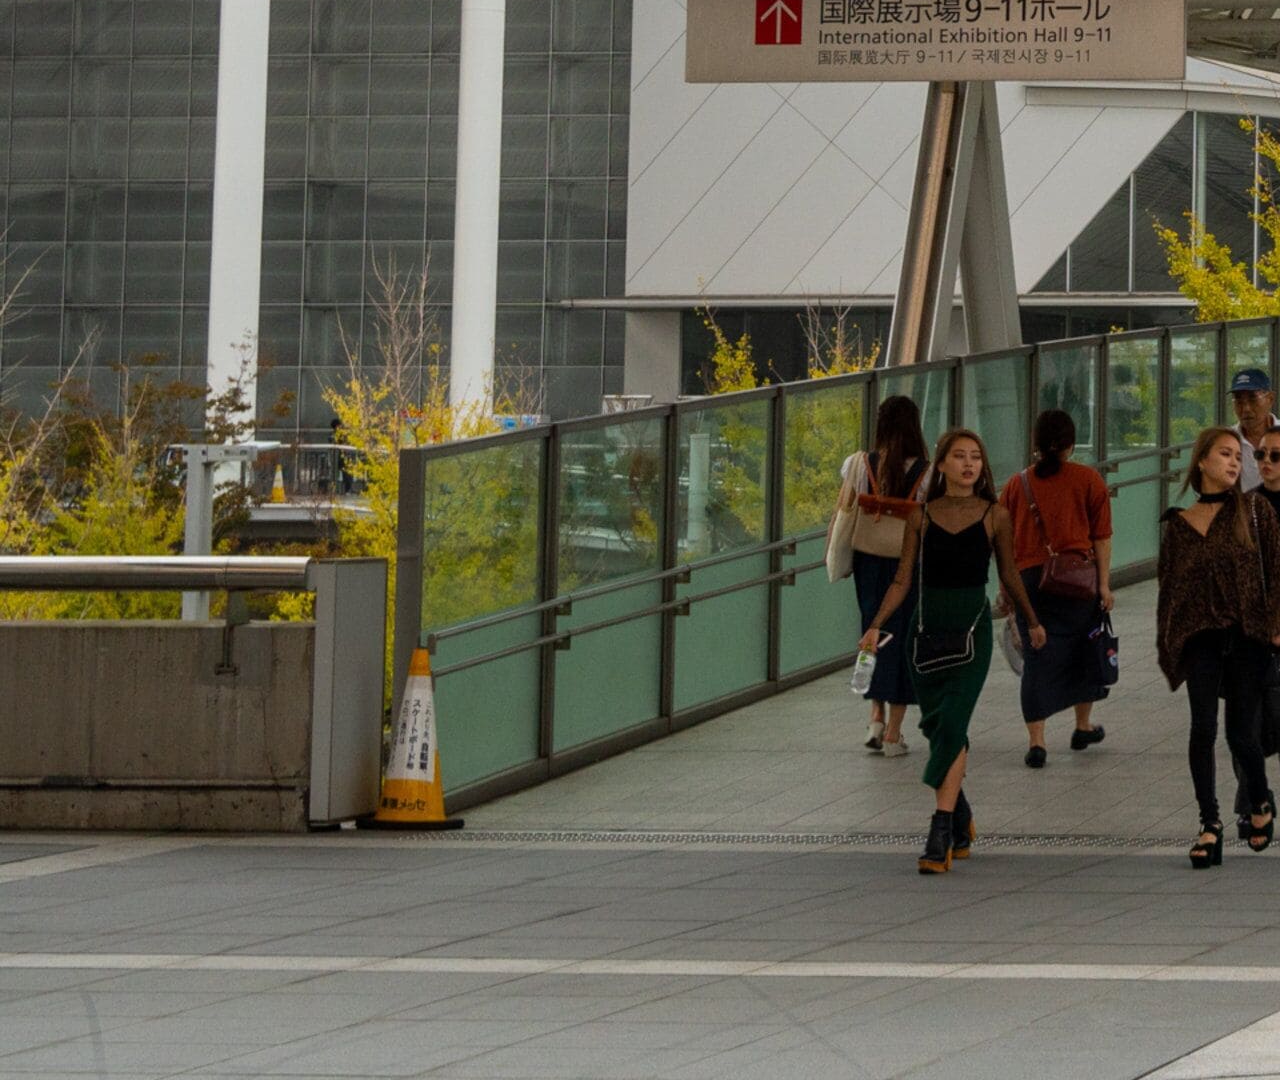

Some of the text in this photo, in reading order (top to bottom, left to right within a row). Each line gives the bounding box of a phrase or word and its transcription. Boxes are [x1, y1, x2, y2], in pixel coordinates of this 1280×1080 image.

[819, 26, 1111, 45] International Exhibition Hall 9-11
[971, 48, 1049, 64] 국제전시장
[1054, 48, 1091, 63] 9-11
